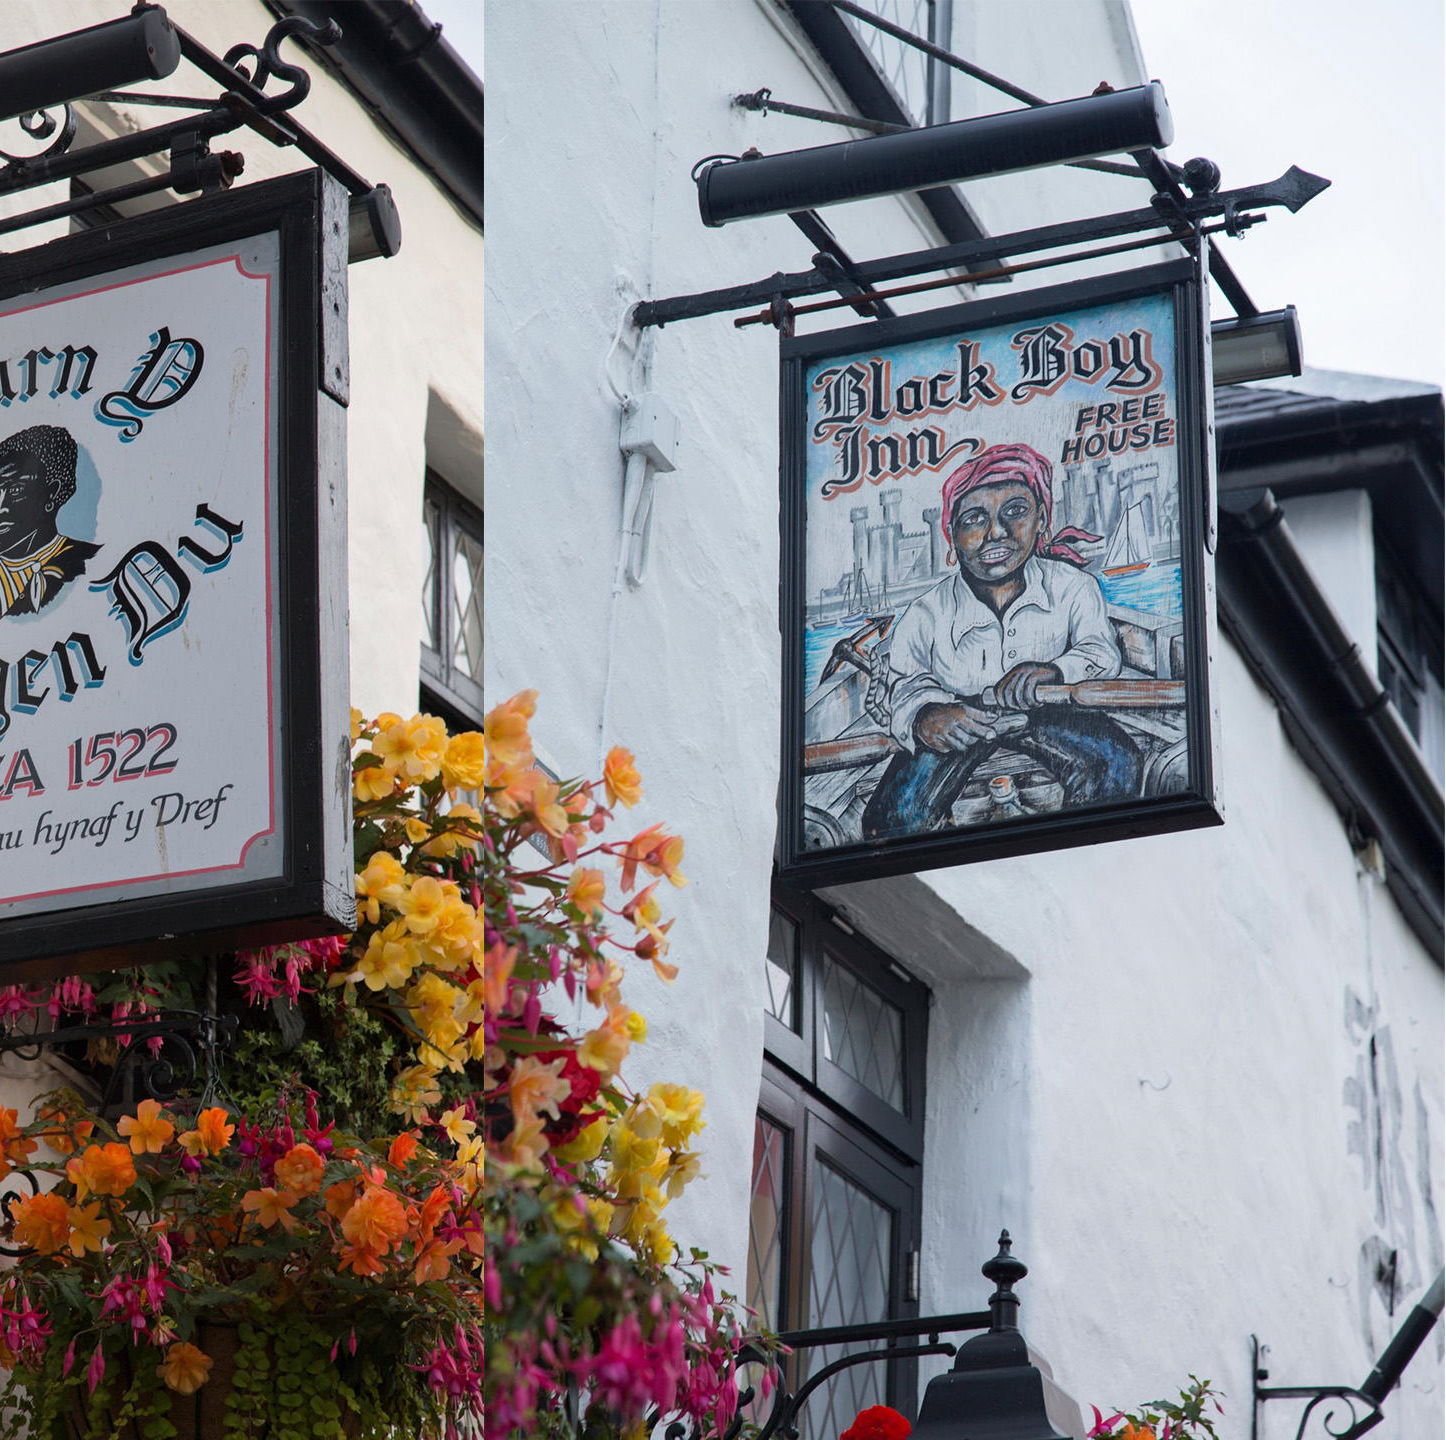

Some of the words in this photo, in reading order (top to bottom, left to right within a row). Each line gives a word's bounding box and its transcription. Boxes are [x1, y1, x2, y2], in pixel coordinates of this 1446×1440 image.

[812, 338, 1007, 443] Black
[1010, 322, 1165, 405] Boy
[1074, 393, 1167, 436] FREE
[820, 423, 986, 500] Inn
[1060, 418, 1176, 466] HOUSE
[88, 502, 244, 667] Du
[67, 722, 180, 791] 1522
[33, 801, 124, 855] hynaf
[124, 808, 145, 842] y
[151, 784, 234, 831] Dref
